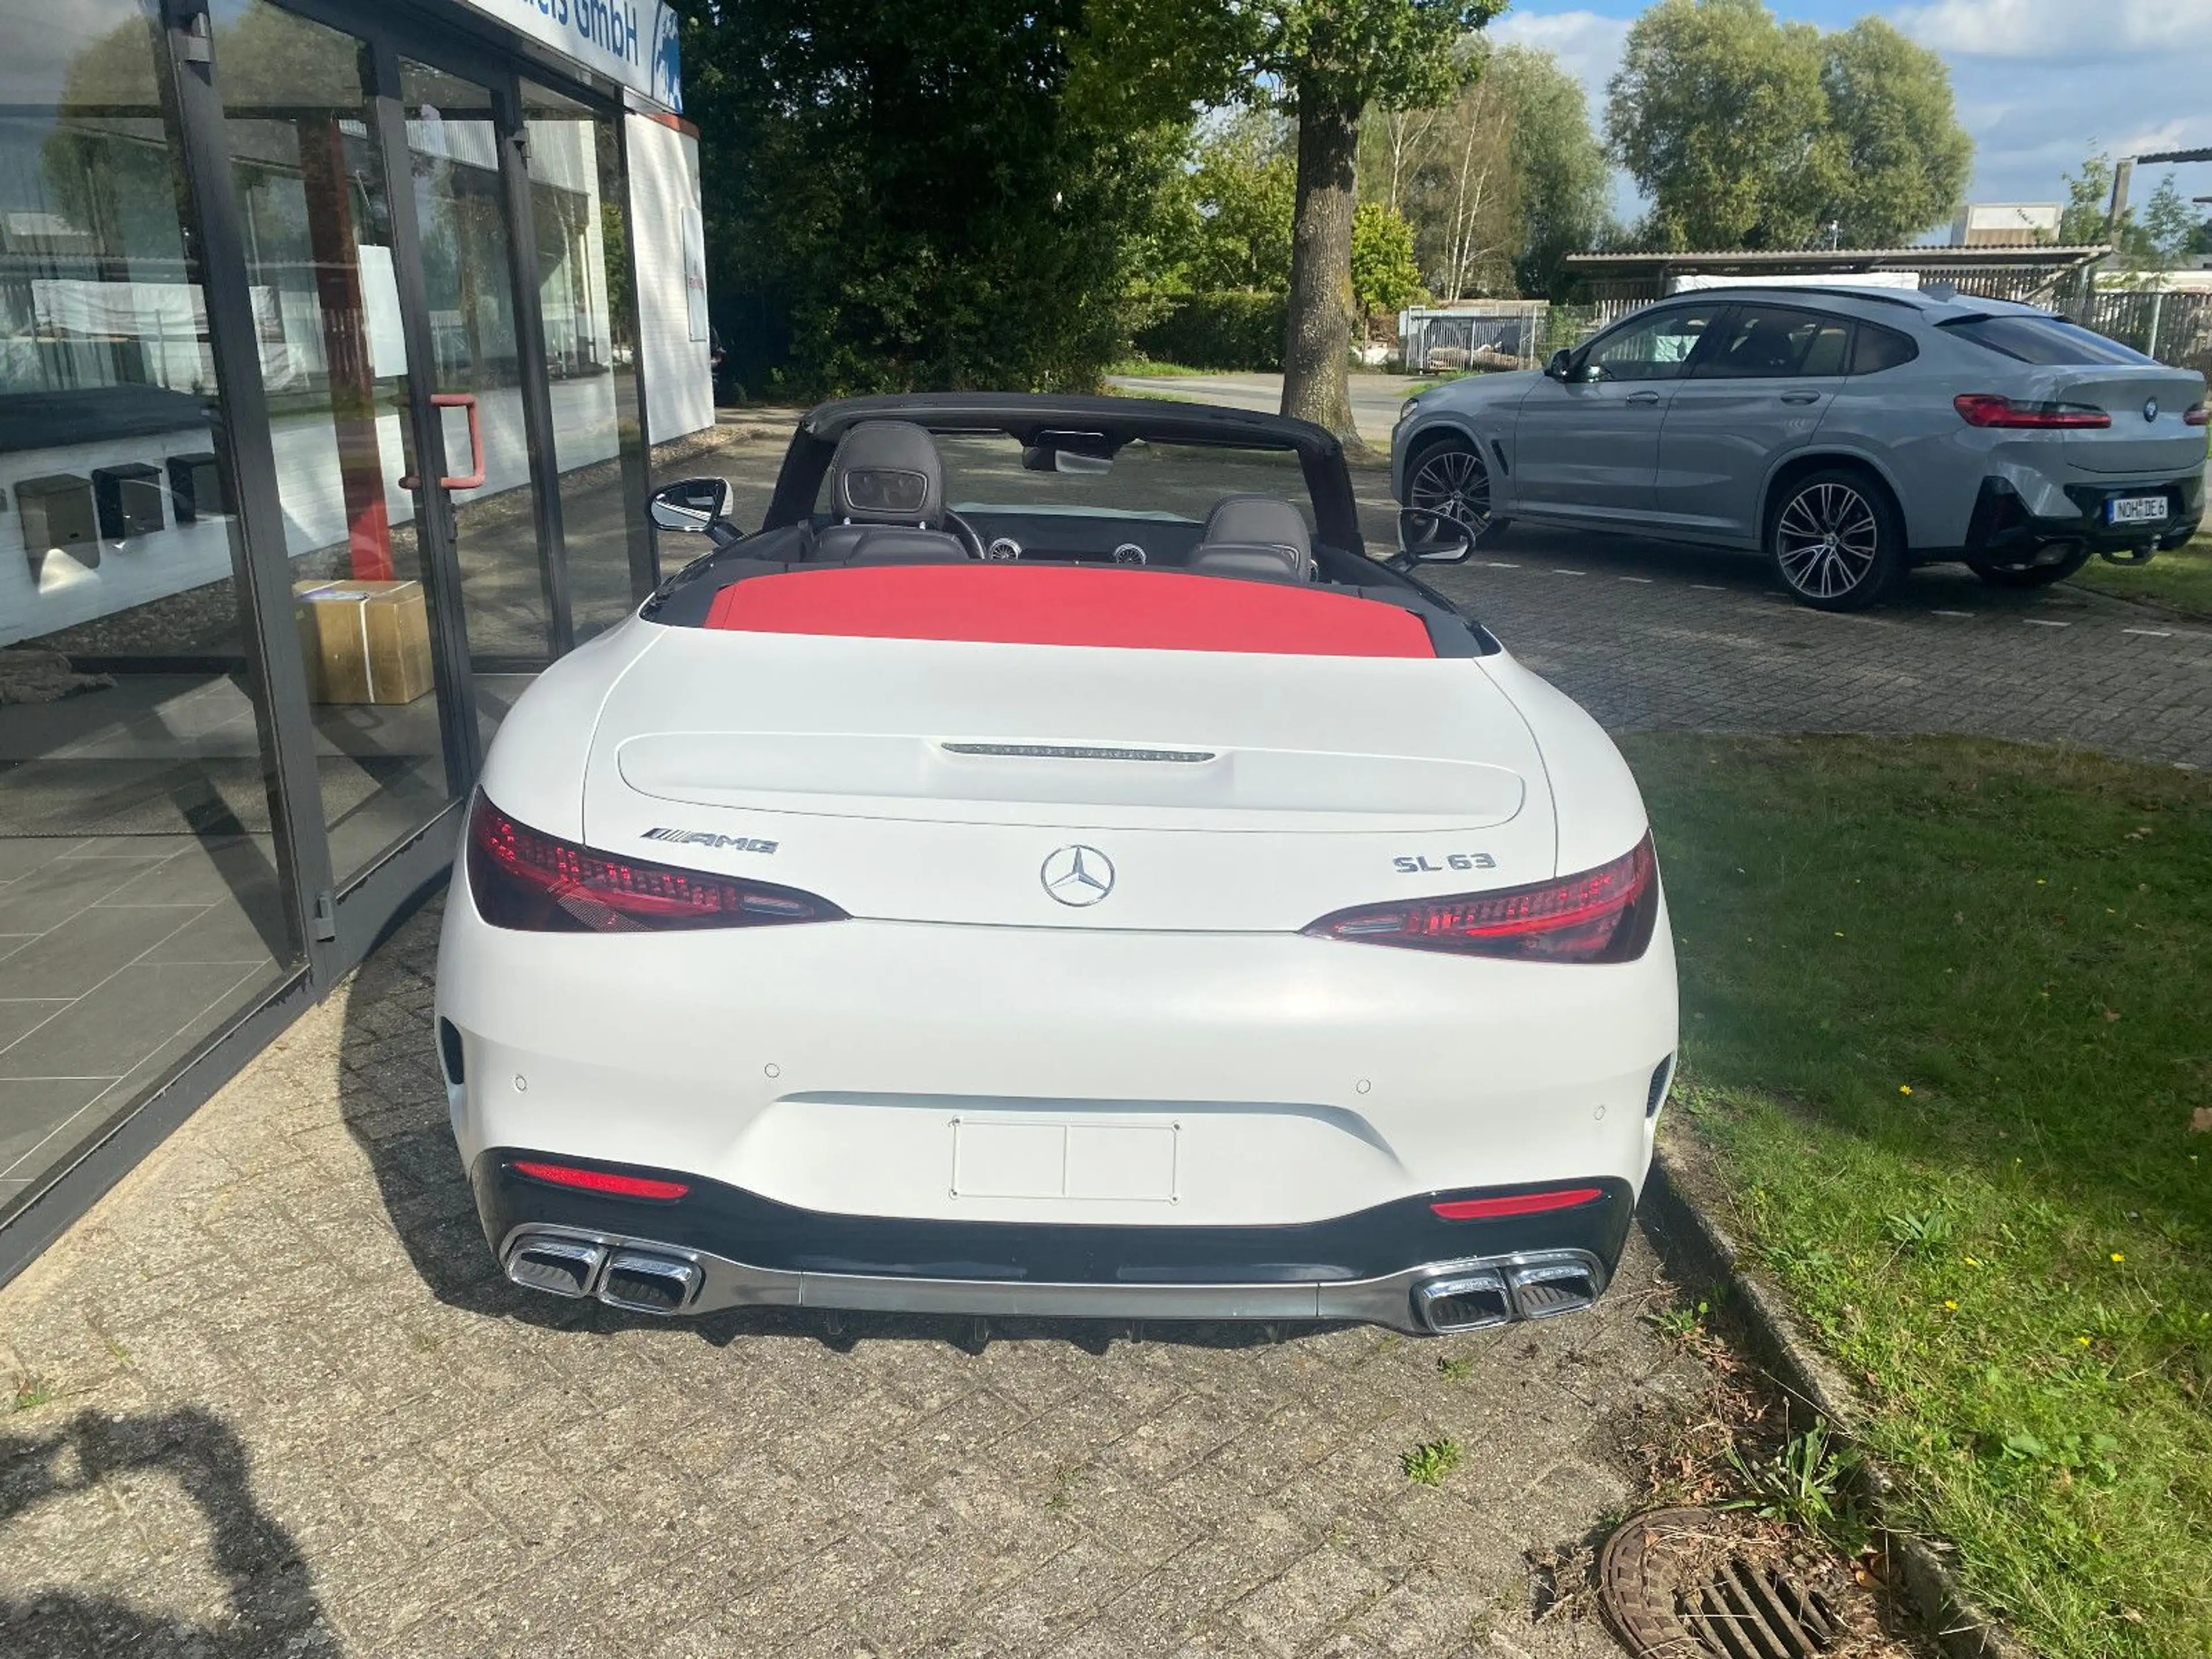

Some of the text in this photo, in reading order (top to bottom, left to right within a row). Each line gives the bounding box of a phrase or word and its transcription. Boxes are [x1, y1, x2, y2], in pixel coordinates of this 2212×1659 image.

[574, 0, 638, 66] GmbH
[681, 831, 779, 853] AMG
[1393, 853, 1497, 873] SL 63
